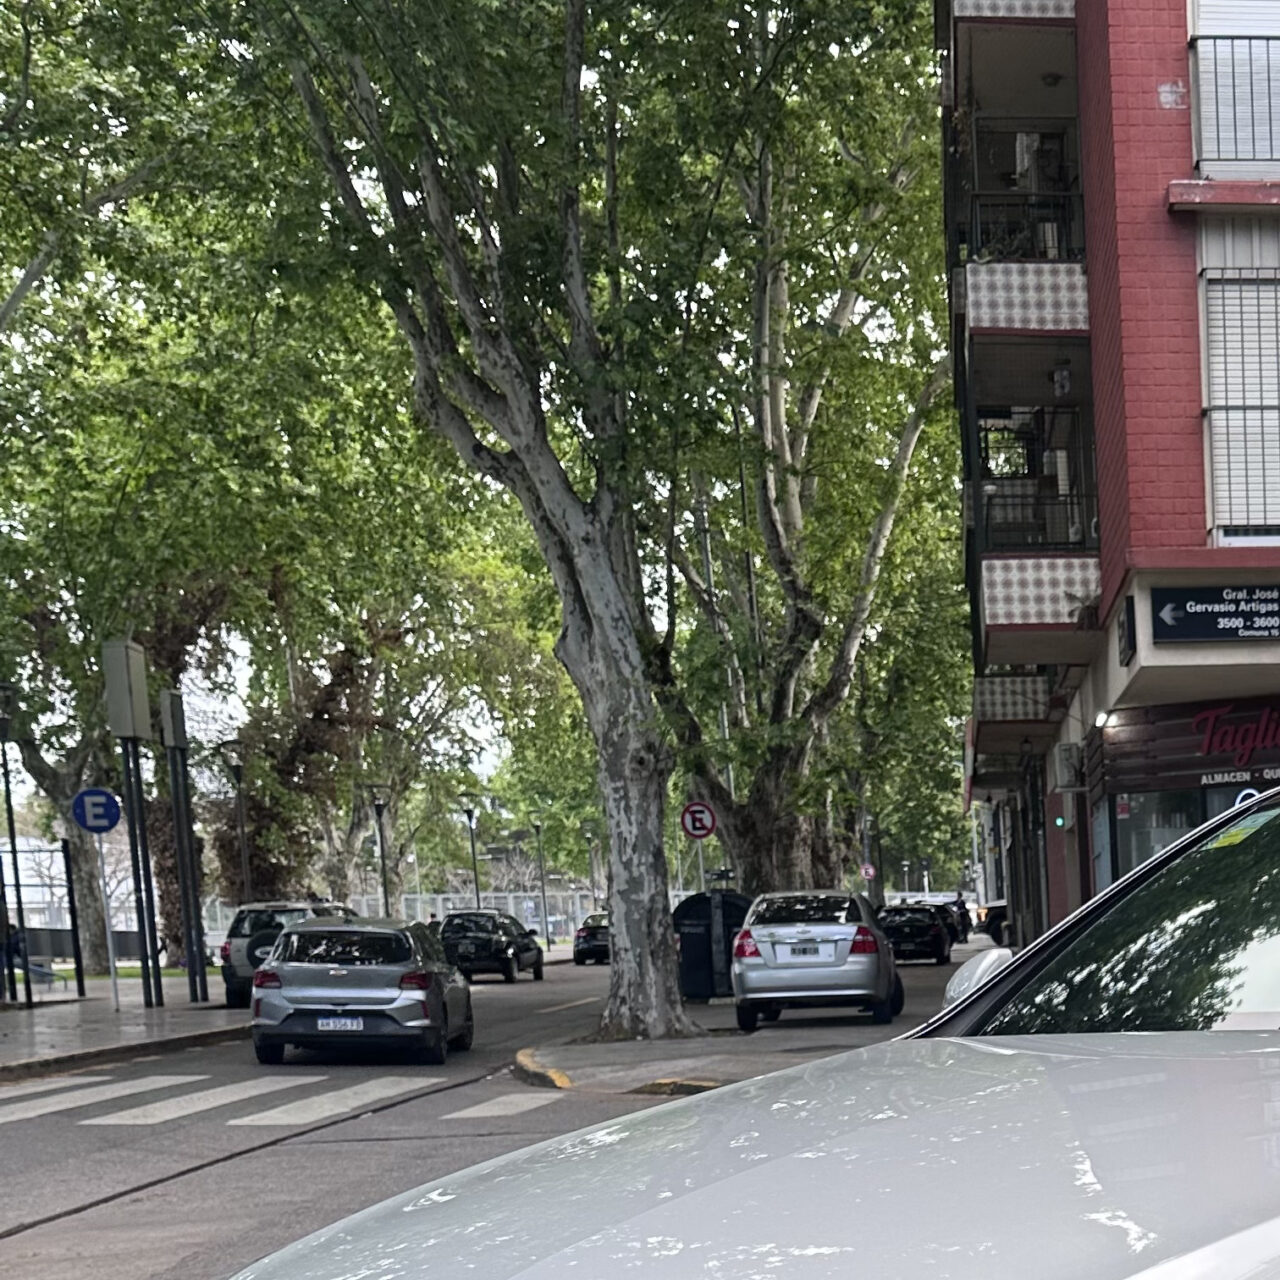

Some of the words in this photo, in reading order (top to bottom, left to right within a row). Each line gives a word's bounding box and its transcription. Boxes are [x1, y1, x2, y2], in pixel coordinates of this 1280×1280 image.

[1222, 588, 1250, 600] Gral.
[1252, 587, 1279, 600] José
[1186, 601, 1236, 613] Gervasio
[1238, 601, 1279, 614] Artigas
[1217, 617, 1244, 629] 3500
[1252, 616, 1280, 628] 3600
[1201, 771, 1251, 785] ALMACEN
[84, 795, 109, 827] E
[689, 809, 706, 831] E
